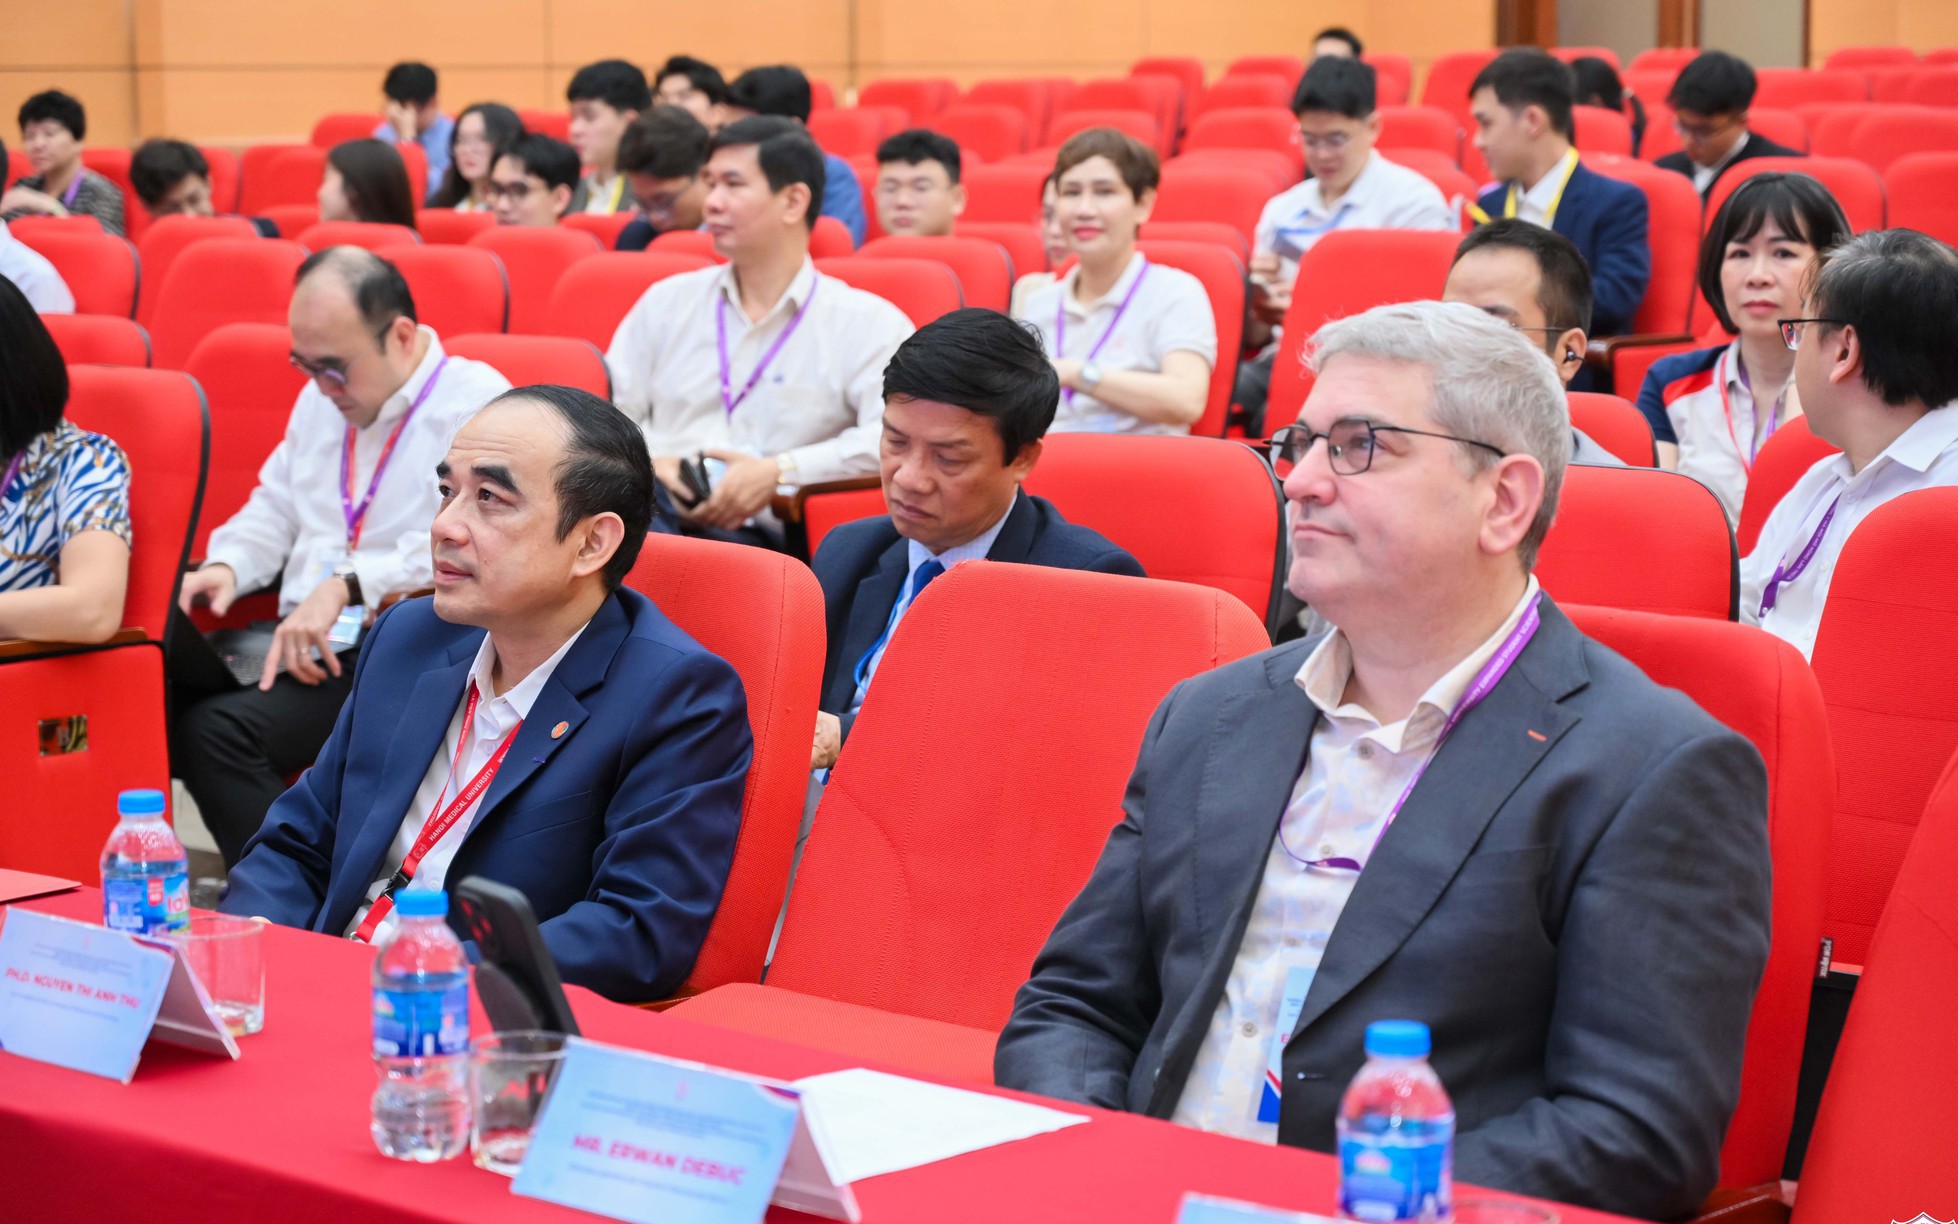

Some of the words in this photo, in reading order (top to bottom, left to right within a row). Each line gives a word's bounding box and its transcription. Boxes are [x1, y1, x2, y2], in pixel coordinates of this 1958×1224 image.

[428, 822, 447, 842] HANOI
[445, 799, 468, 825] MEDICAL
[464, 767, 495, 801] UNIVERSITY
